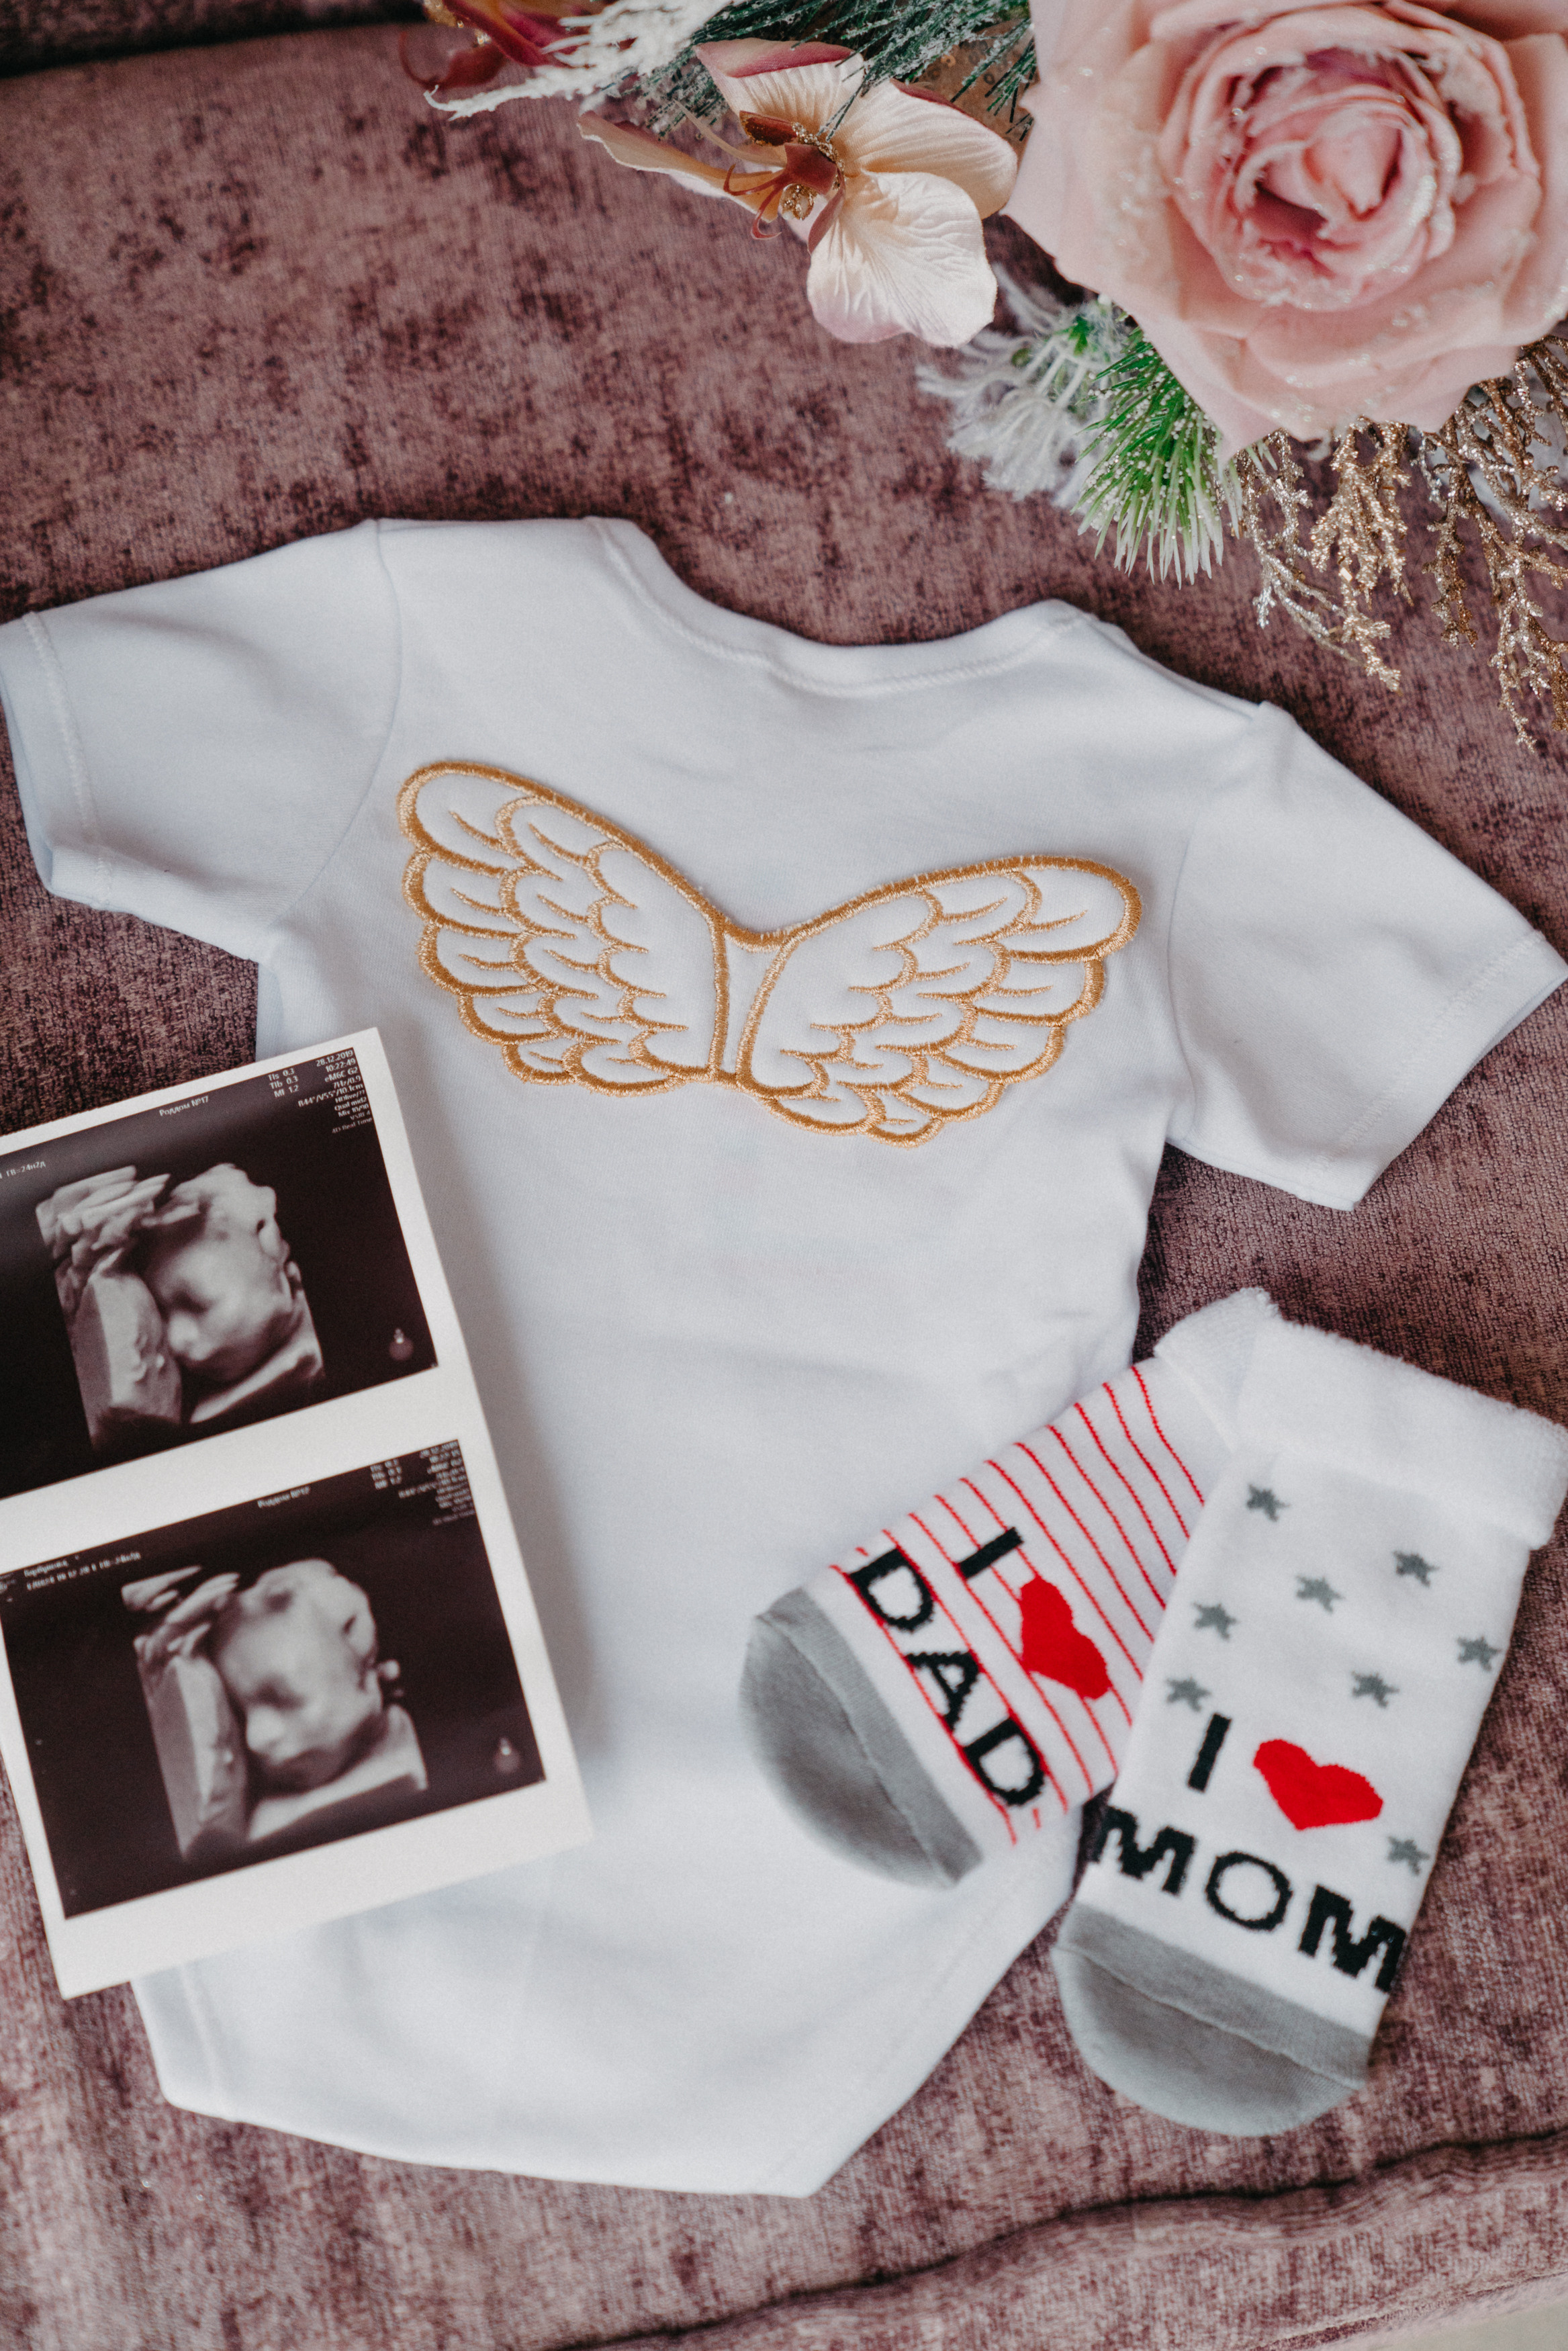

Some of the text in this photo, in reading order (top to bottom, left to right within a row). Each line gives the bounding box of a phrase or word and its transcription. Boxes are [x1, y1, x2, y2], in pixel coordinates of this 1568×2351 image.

[316, 1050, 353, 1067] 28.12.2019
[326, 1058, 356, 1073] 10:22:49
[282, 1068, 295, 1077] 0.3
[286, 1075, 298, 1085] 0.3
[324, 1067, 359, 1083] eM6C G2
[288, 1085, 299, 1094] 1.2
[958, 1527, 1023, 1579] I
[849, 1548, 1048, 1806] DAD
[1187, 1712, 1232, 1792] I
[1093, 1806, 1407, 1993] MOM
